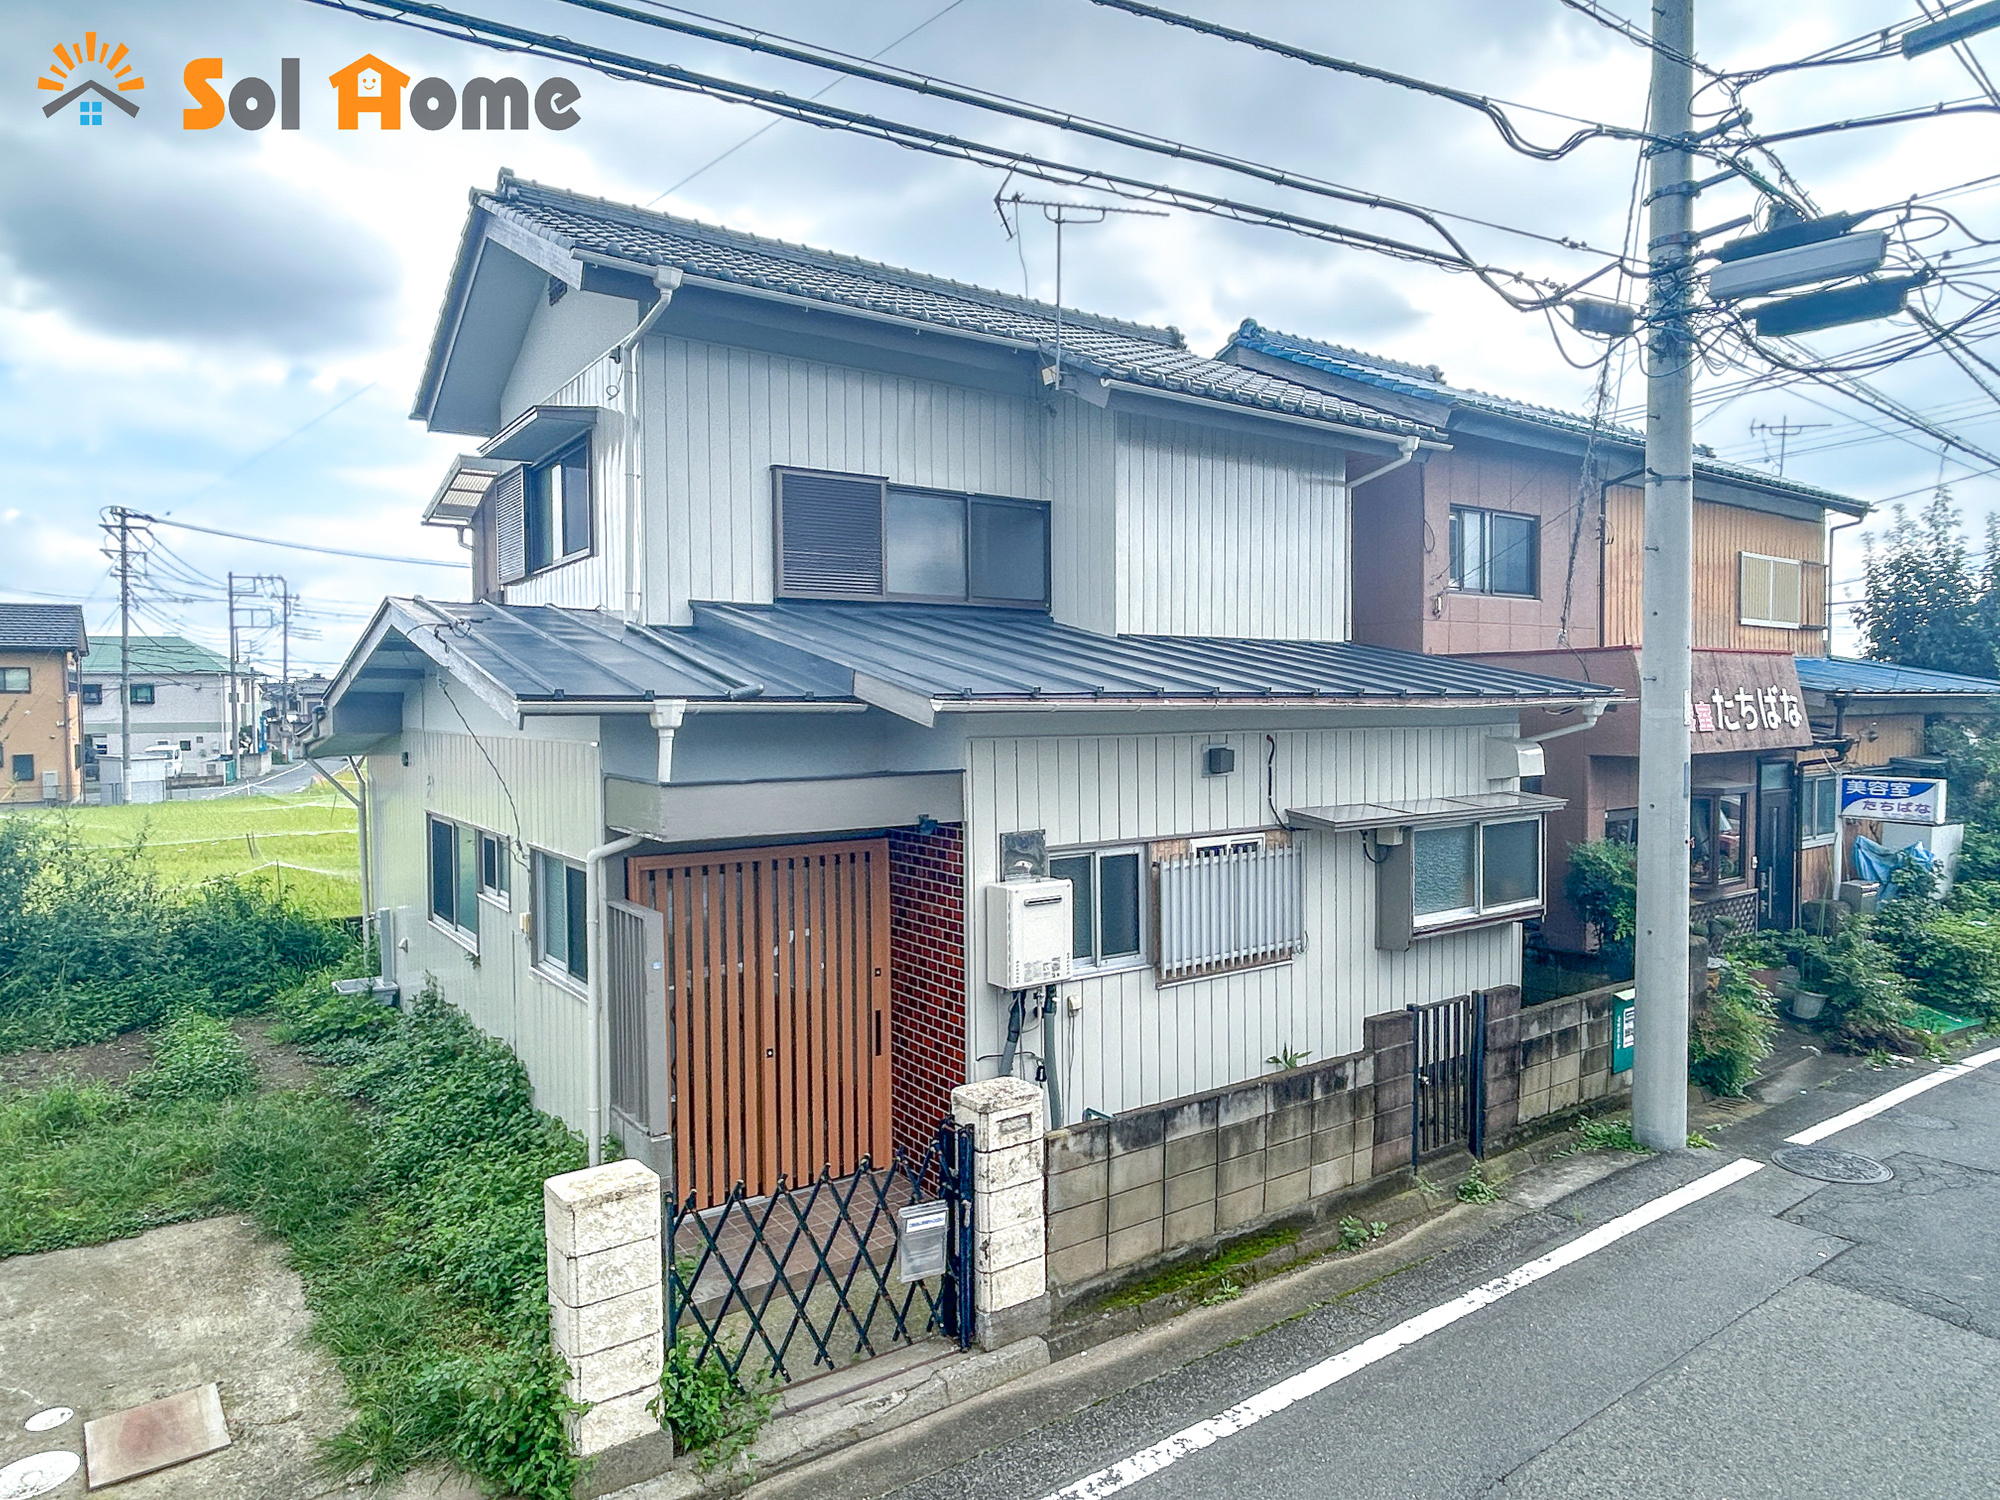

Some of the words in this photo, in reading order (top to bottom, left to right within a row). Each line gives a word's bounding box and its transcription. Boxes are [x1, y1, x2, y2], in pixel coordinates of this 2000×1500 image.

[1845, 780, 1911, 798] 美容室
[1862, 799, 1932, 815] たちばな
